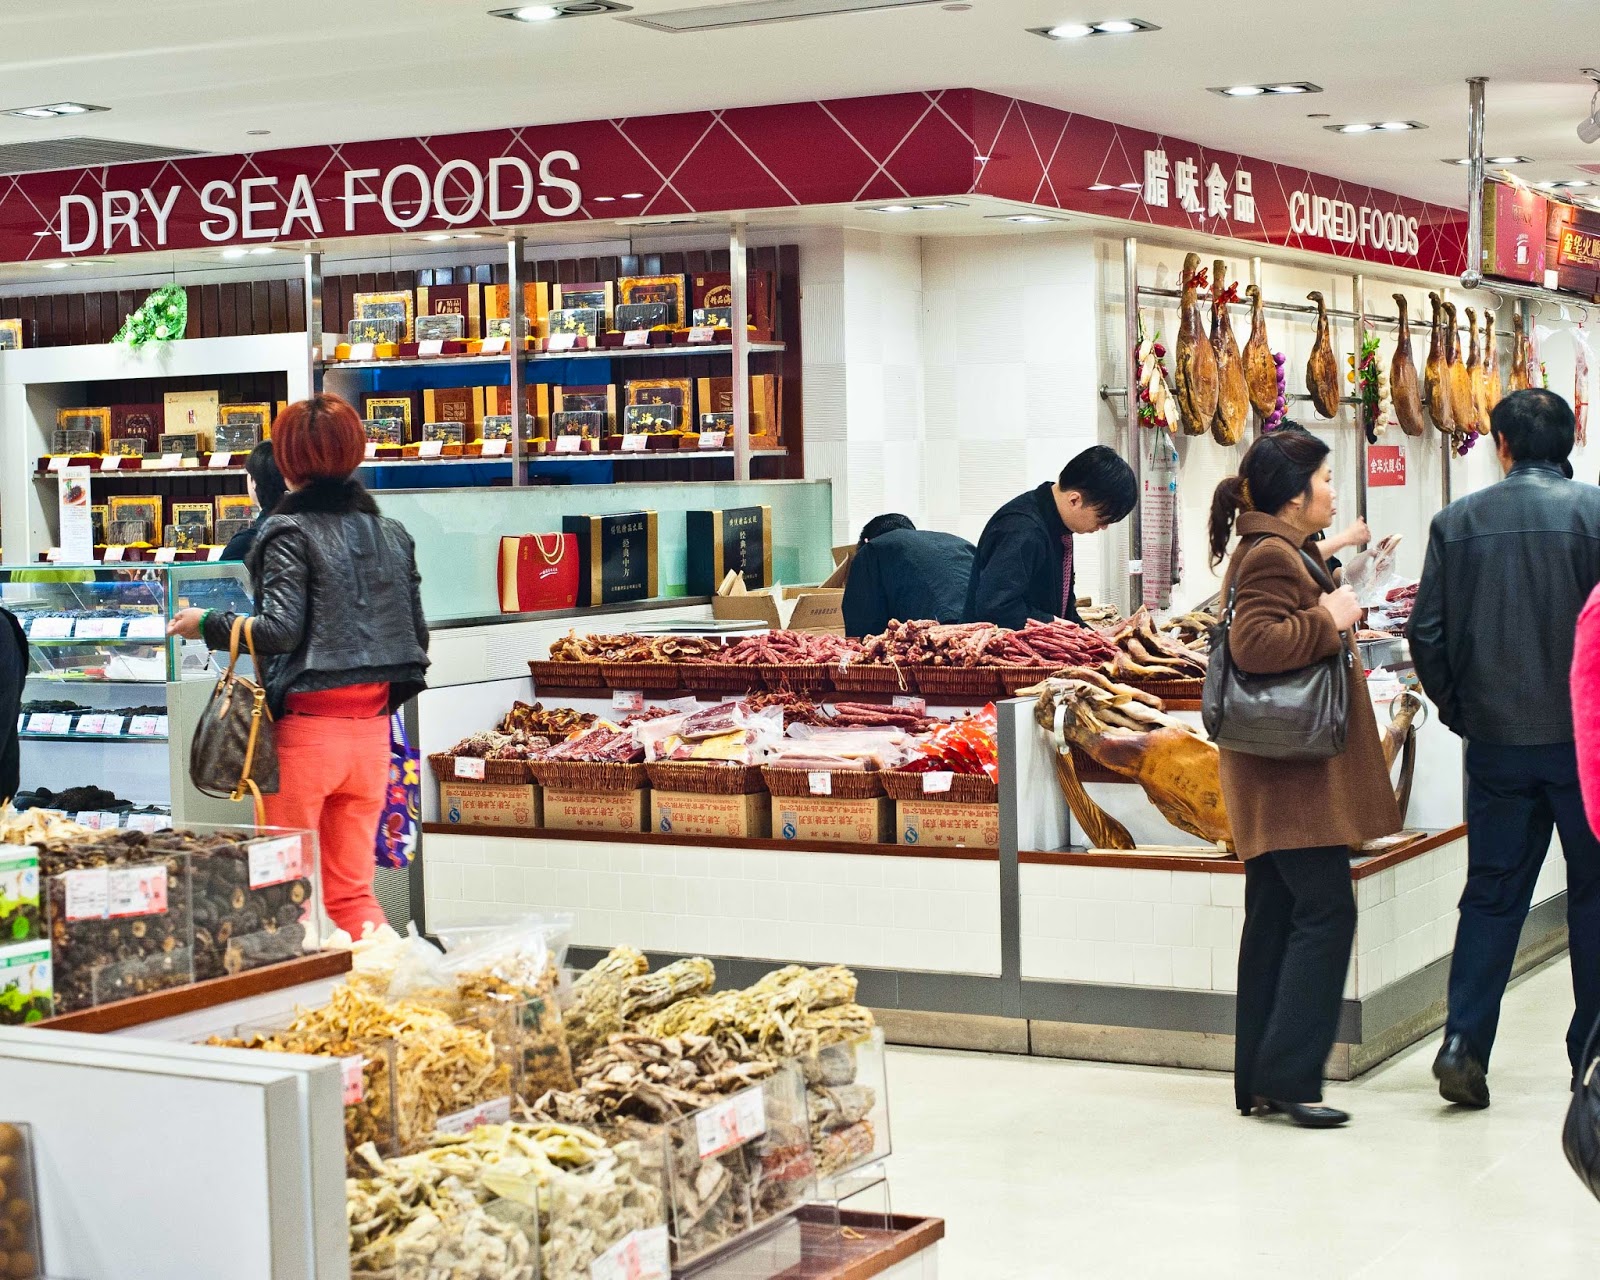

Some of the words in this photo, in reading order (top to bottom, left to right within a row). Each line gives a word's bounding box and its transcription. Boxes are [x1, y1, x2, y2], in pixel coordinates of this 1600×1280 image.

[59, 184, 182, 255] DRY
[198, 172, 324, 243] SEA
[343, 149, 583, 233] FOODS
[1143, 148, 1256, 225] 腊味食品
[1289, 189, 1357, 245] CURED
[1358, 205, 1420, 257] FOODS
